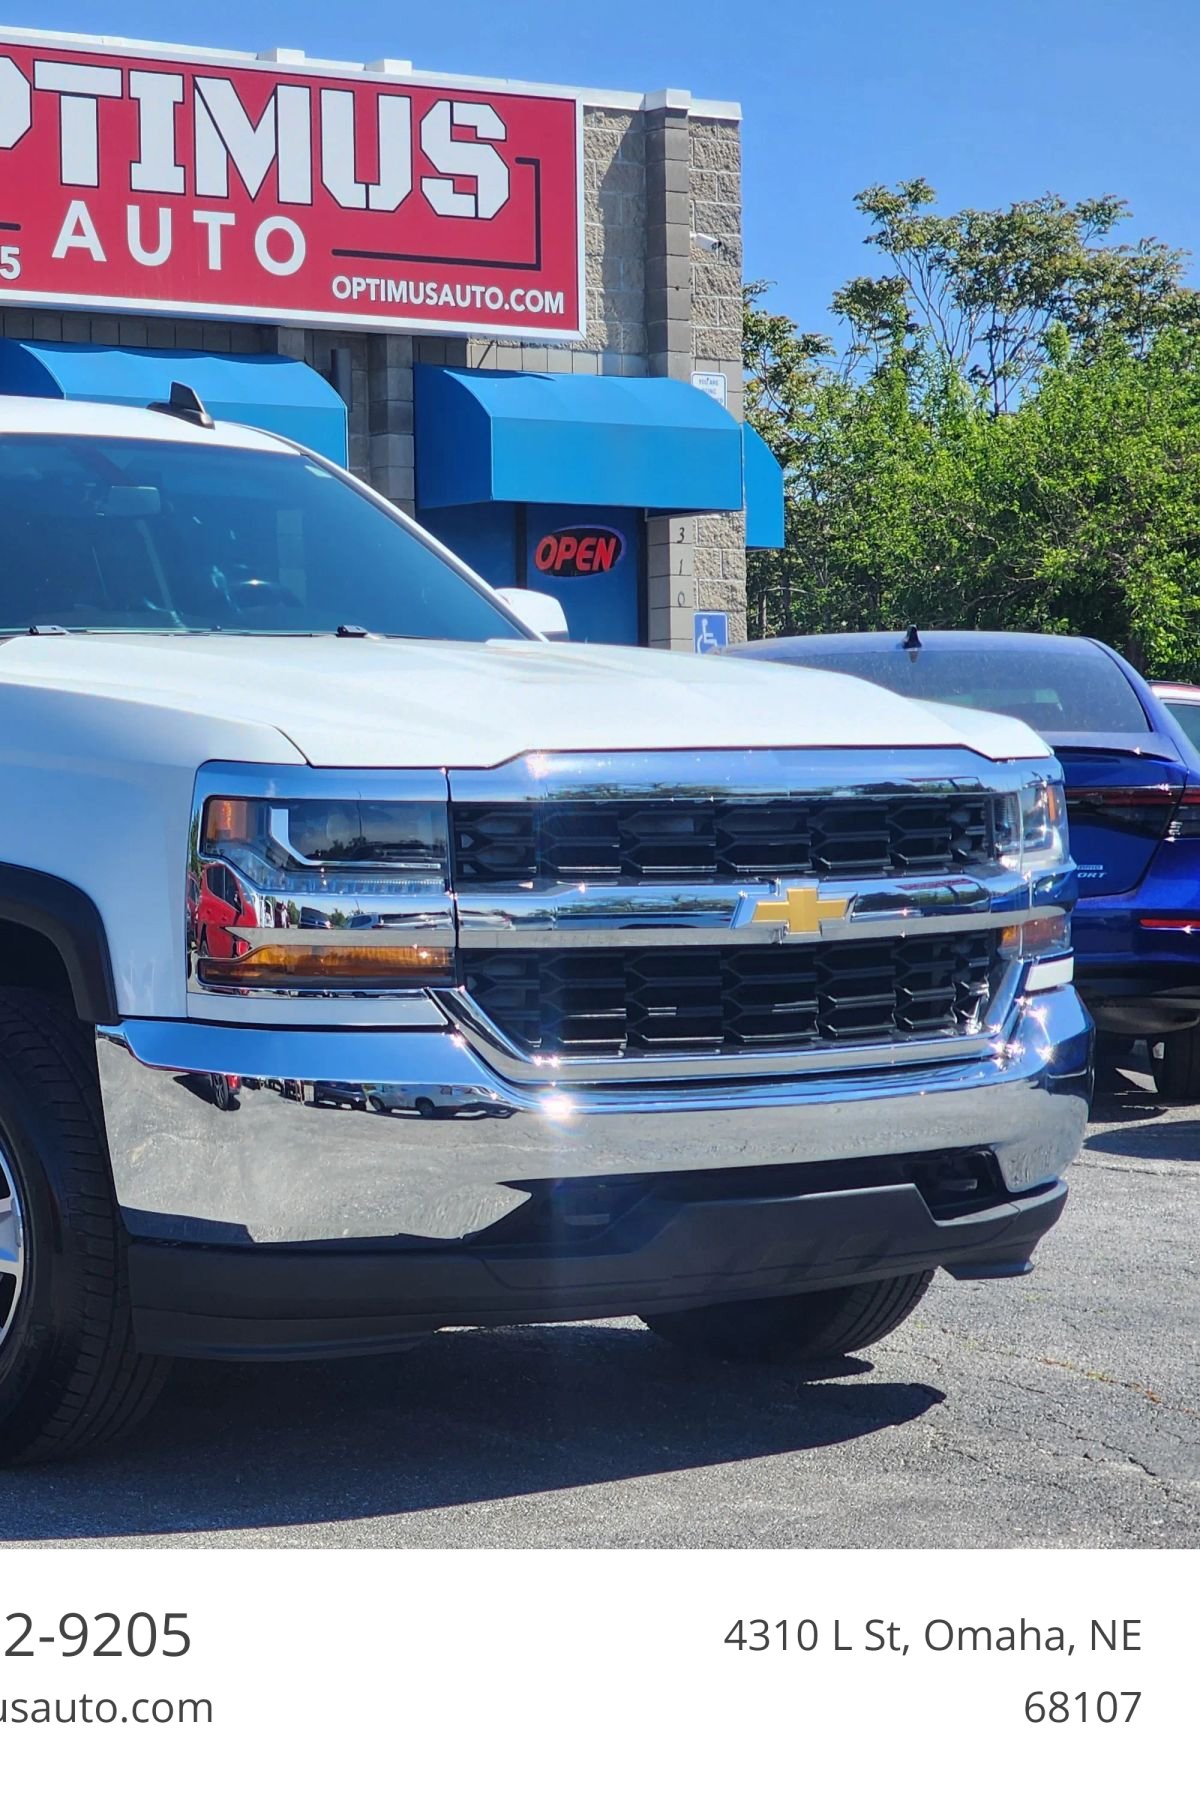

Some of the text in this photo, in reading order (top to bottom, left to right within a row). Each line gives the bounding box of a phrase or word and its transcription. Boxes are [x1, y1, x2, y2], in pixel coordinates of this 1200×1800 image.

[51, 199, 307, 277] AUTO
[331, 275, 566, 314] OPTIMUSAUTO.COM
[535, 535, 617, 572] OPEN
